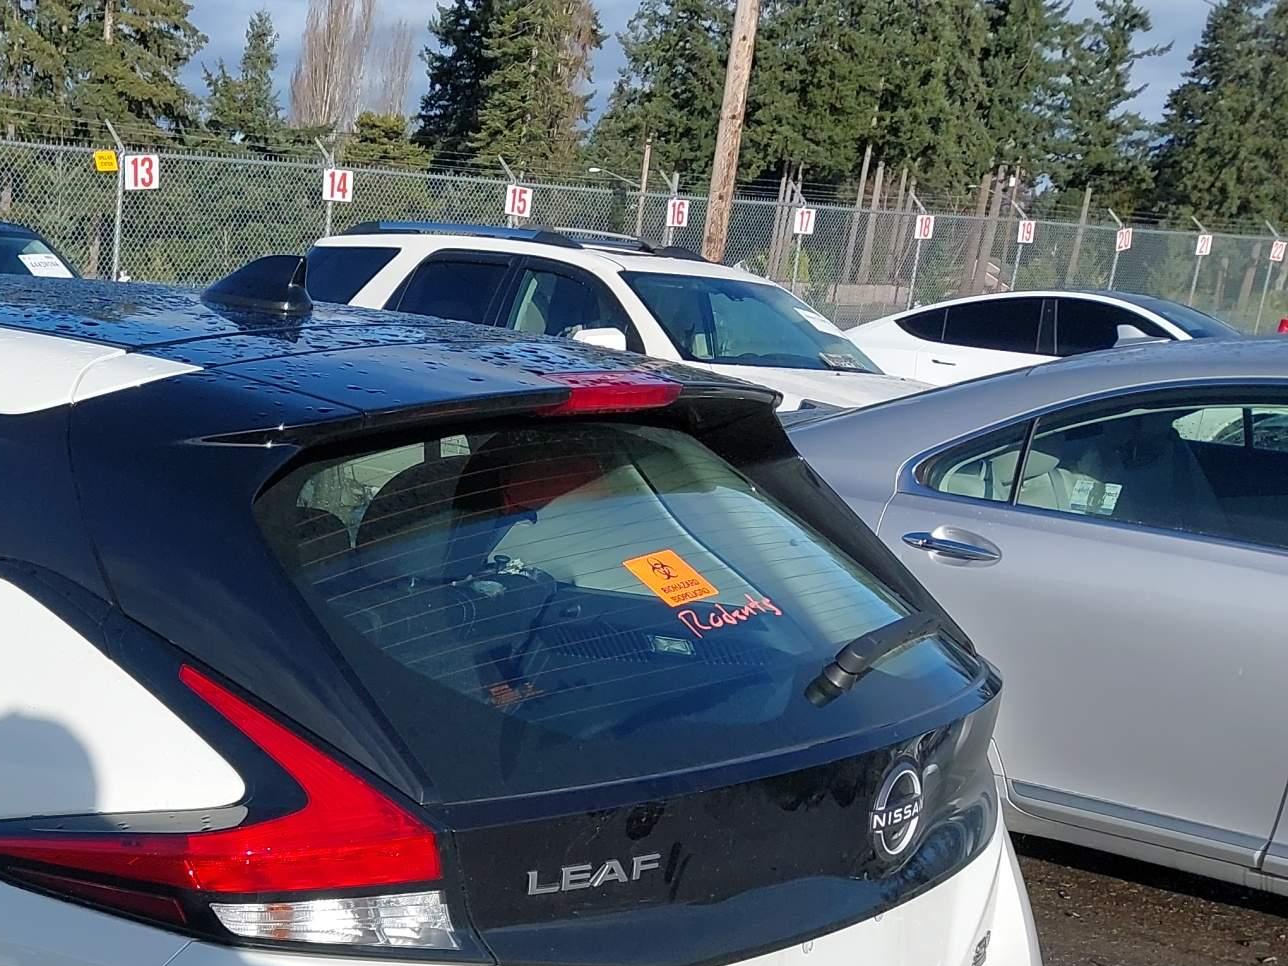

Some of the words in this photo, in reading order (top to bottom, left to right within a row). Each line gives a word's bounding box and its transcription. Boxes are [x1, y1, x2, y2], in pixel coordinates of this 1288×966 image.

[131, 157, 153, 188] 13
[329, 171, 348, 199] 14
[511, 187, 527, 214] 15
[672, 201, 685, 225] 16
[800, 210, 812, 232] 17
[919, 216, 931, 238] 18
[1021, 222, 1033, 242] 19
[1117, 230, 1131, 250] 20
[1198, 236, 1211, 255] 21
[1271, 242, 1286, 260] 22
[872, 800, 923, 829] NISSA
[527, 853, 662, 896] LEAF
